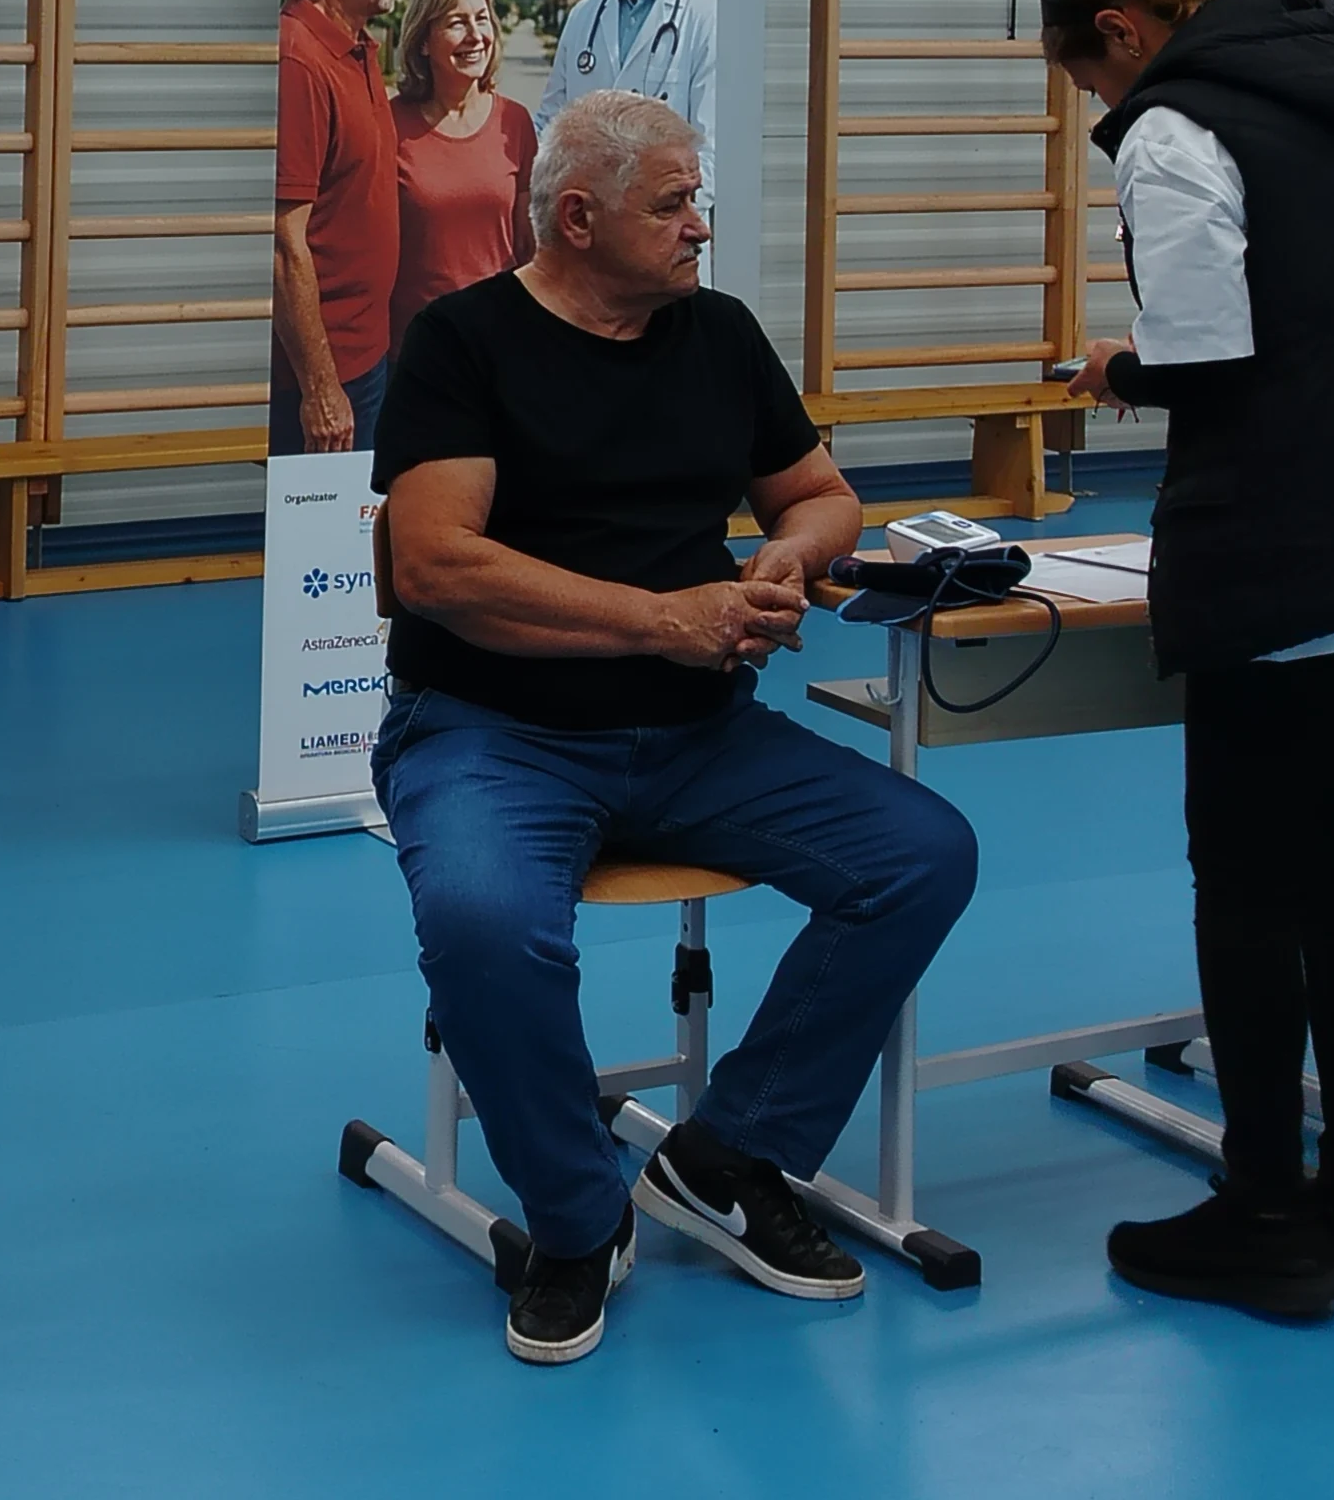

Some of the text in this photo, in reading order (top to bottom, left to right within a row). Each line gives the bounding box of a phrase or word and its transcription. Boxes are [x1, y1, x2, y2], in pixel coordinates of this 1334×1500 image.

[284, 493, 338, 505] Organizator
[333, 571, 374, 594] syn
[302, 634, 378, 652] AstraZeneca
[300, 732, 360, 750] LIAMED
